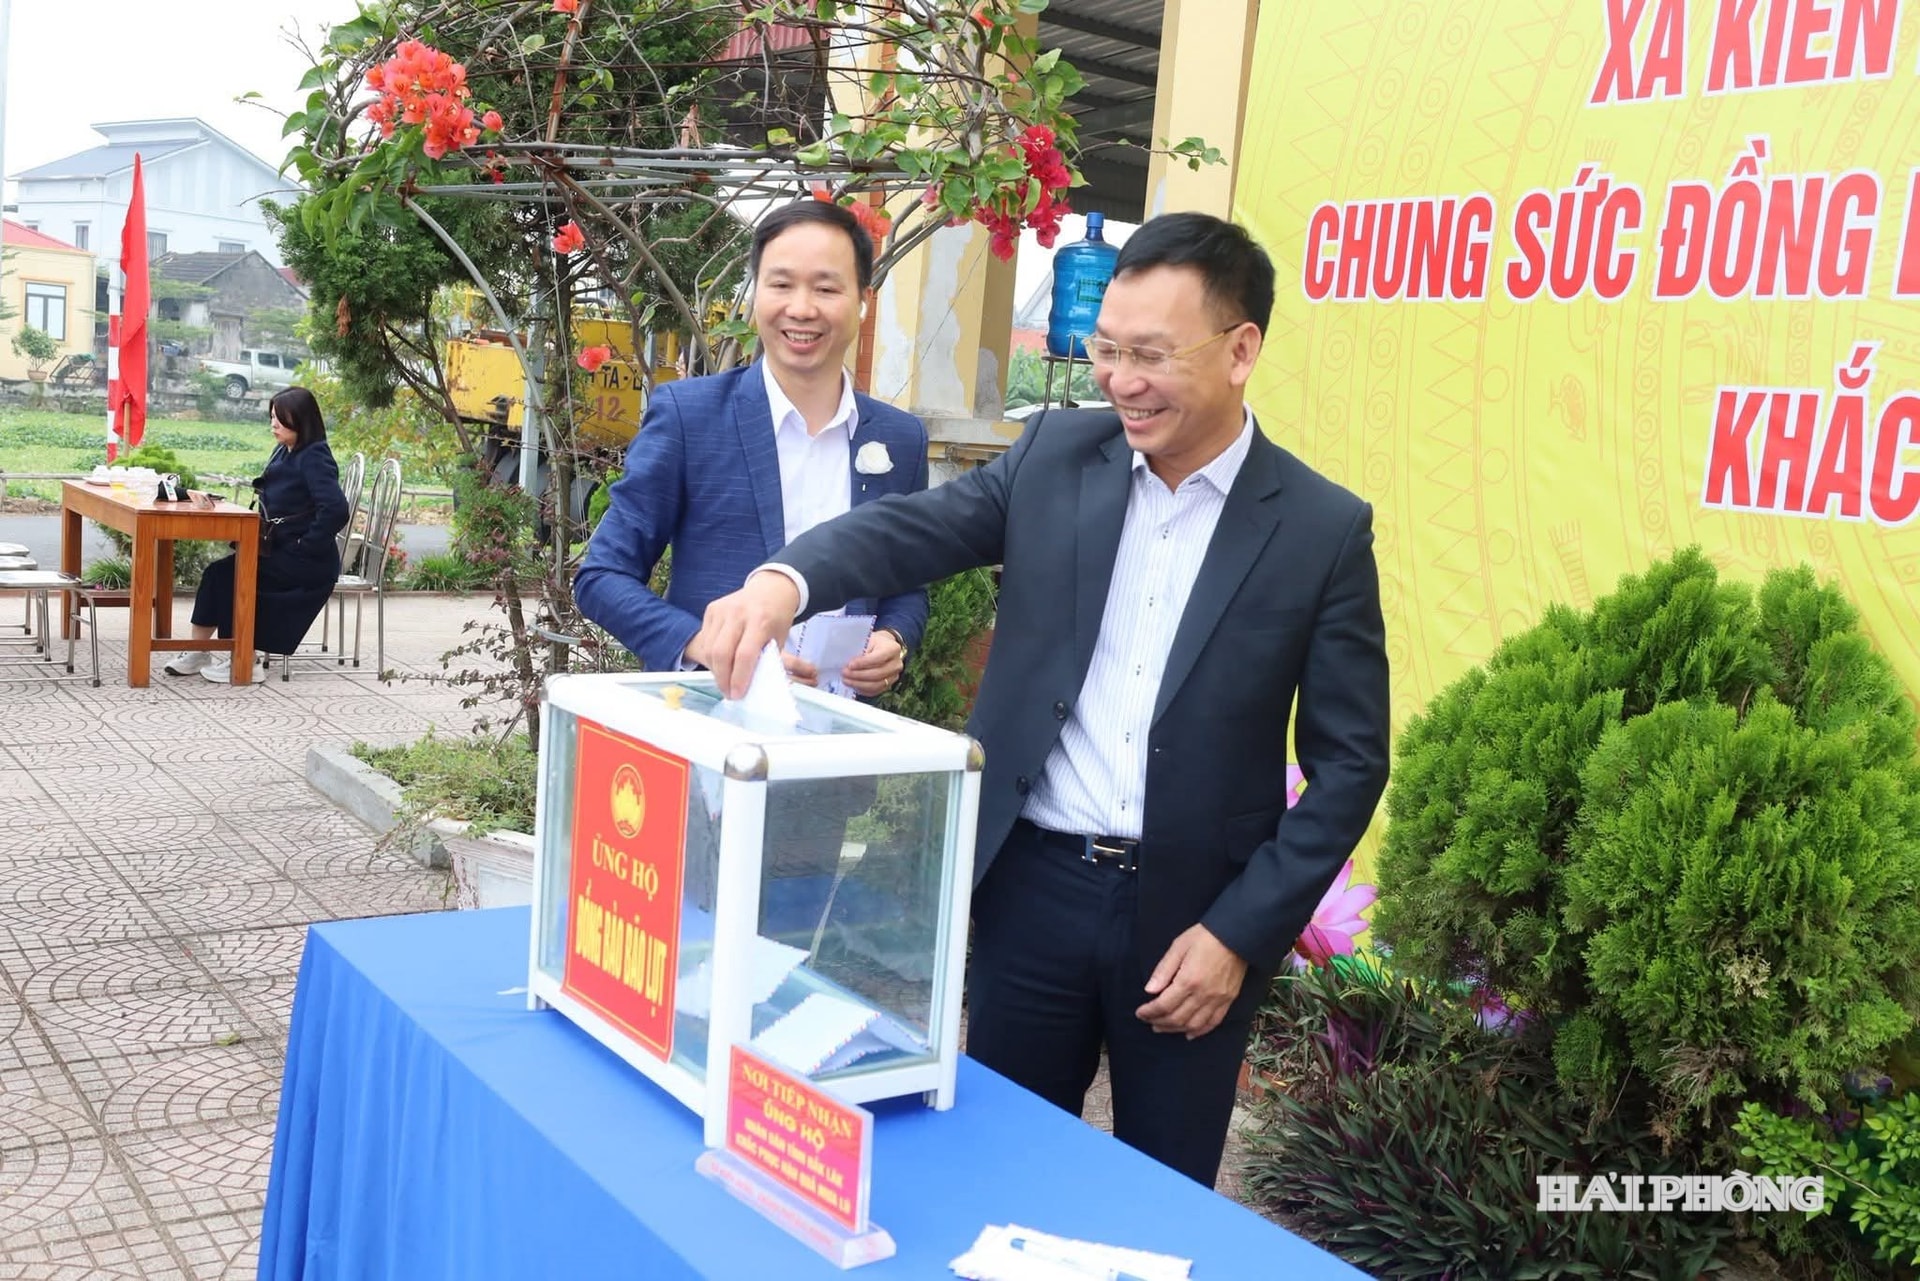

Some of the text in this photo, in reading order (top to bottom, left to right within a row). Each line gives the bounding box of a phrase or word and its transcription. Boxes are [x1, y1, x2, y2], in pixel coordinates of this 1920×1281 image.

[1304, 197, 1493, 299] CHUNG
[1506, 168, 1642, 299] SỨC
[1656, 139, 1879, 297] ĐỒNG
[596, 395, 621, 421] 12
[1705, 346, 1920, 522] KHẮC
[631, 858, 659, 901] HỘ
